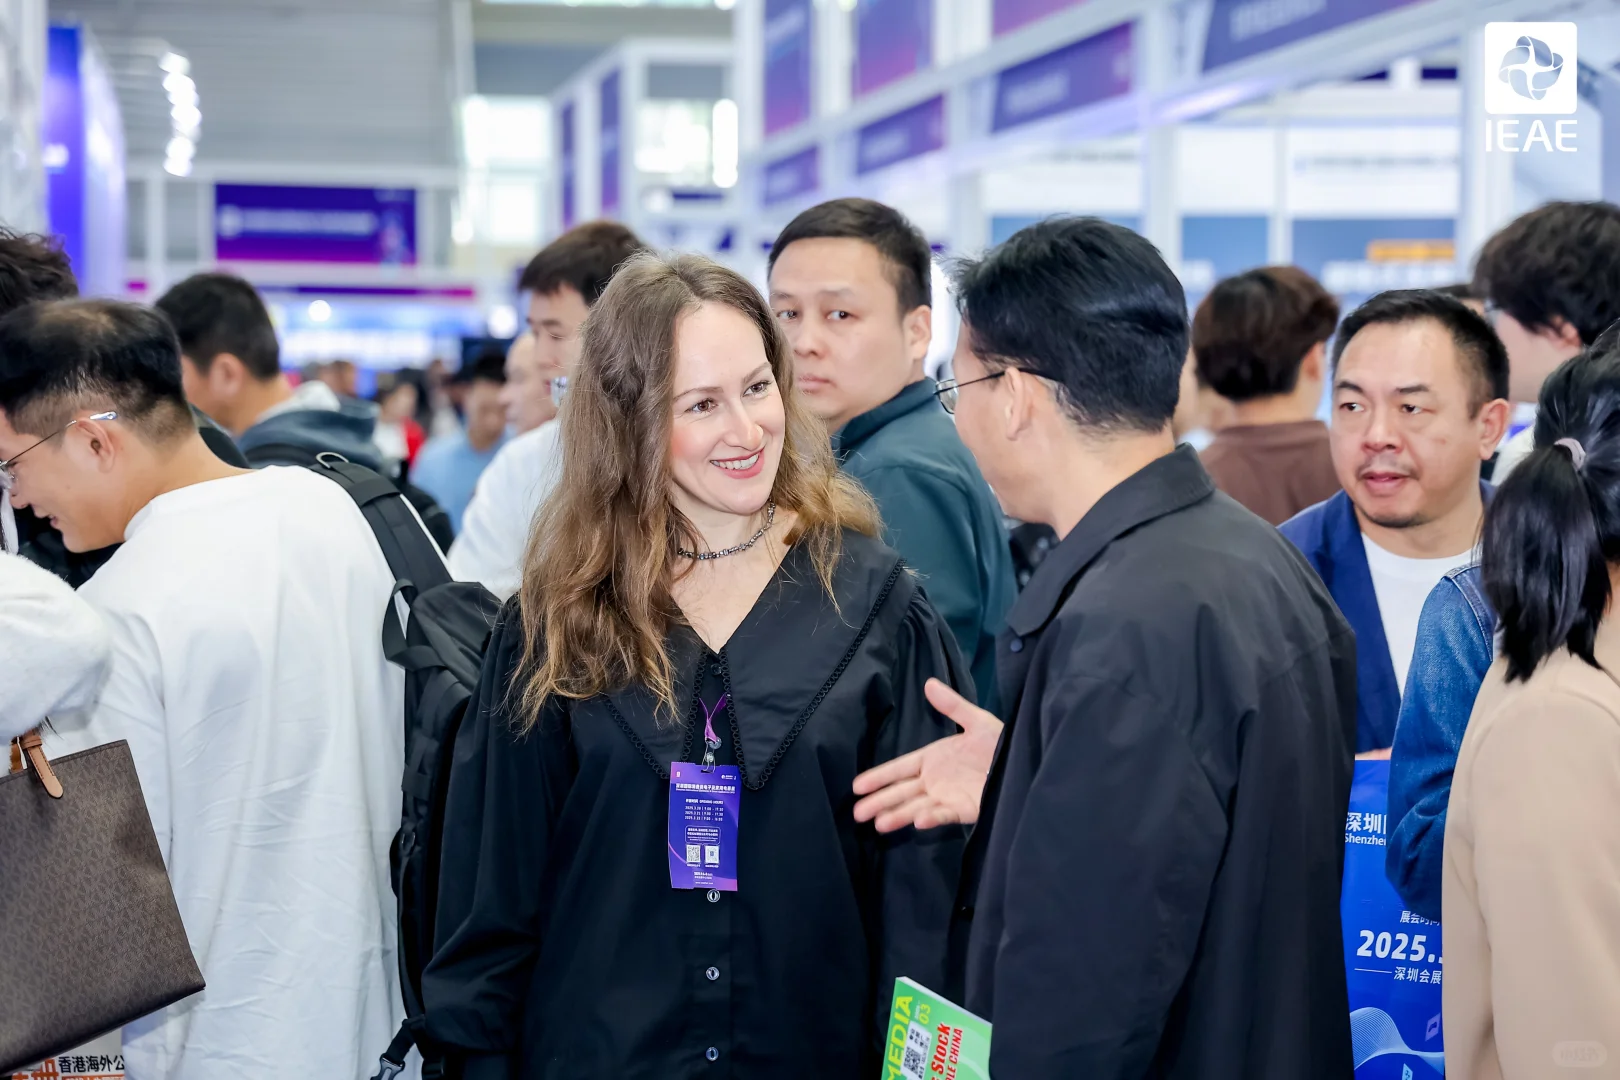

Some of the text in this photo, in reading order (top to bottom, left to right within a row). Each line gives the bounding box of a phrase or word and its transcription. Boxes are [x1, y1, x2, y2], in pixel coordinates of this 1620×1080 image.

[1345, 811, 1387, 835] 深圳
[1344, 832, 1386, 846] Shenzhe
[1400, 910, 1440, 926] 展会
[1356, 929, 1442, 964] 2025.
[1393, 966, 1442, 985] 深圳会展
[918, 1003, 931, 1025] 03
[930, 1021, 952, 1075] Stock
[948, 1027, 963, 1065] CHINA
[58, 1054, 124, 1073] 香港海外公
